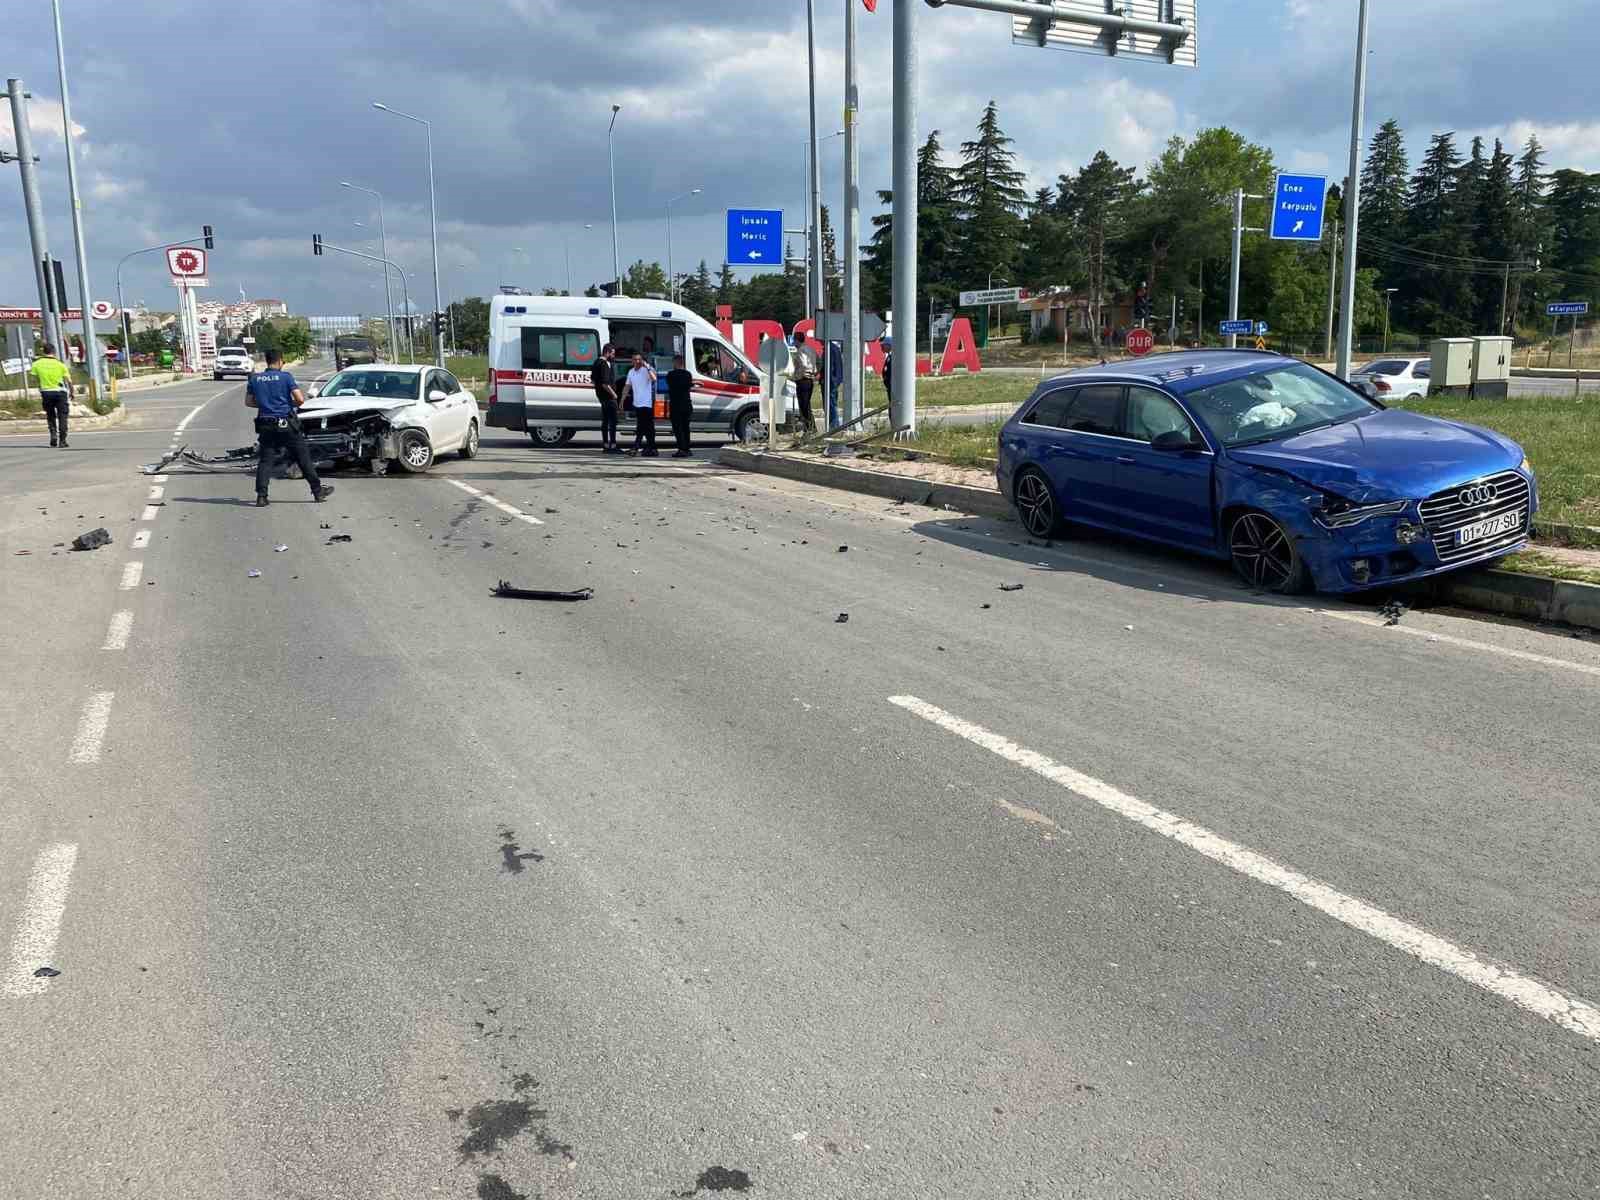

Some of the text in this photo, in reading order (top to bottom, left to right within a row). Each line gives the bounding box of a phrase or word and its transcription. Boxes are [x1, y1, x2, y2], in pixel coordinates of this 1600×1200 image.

[1283, 183, 1304, 193] Enez
[1281, 200, 1317, 213] Karpuzlu
[1128, 336, 1151, 347] DUR
[525, 371, 592, 384] AMBULANS
